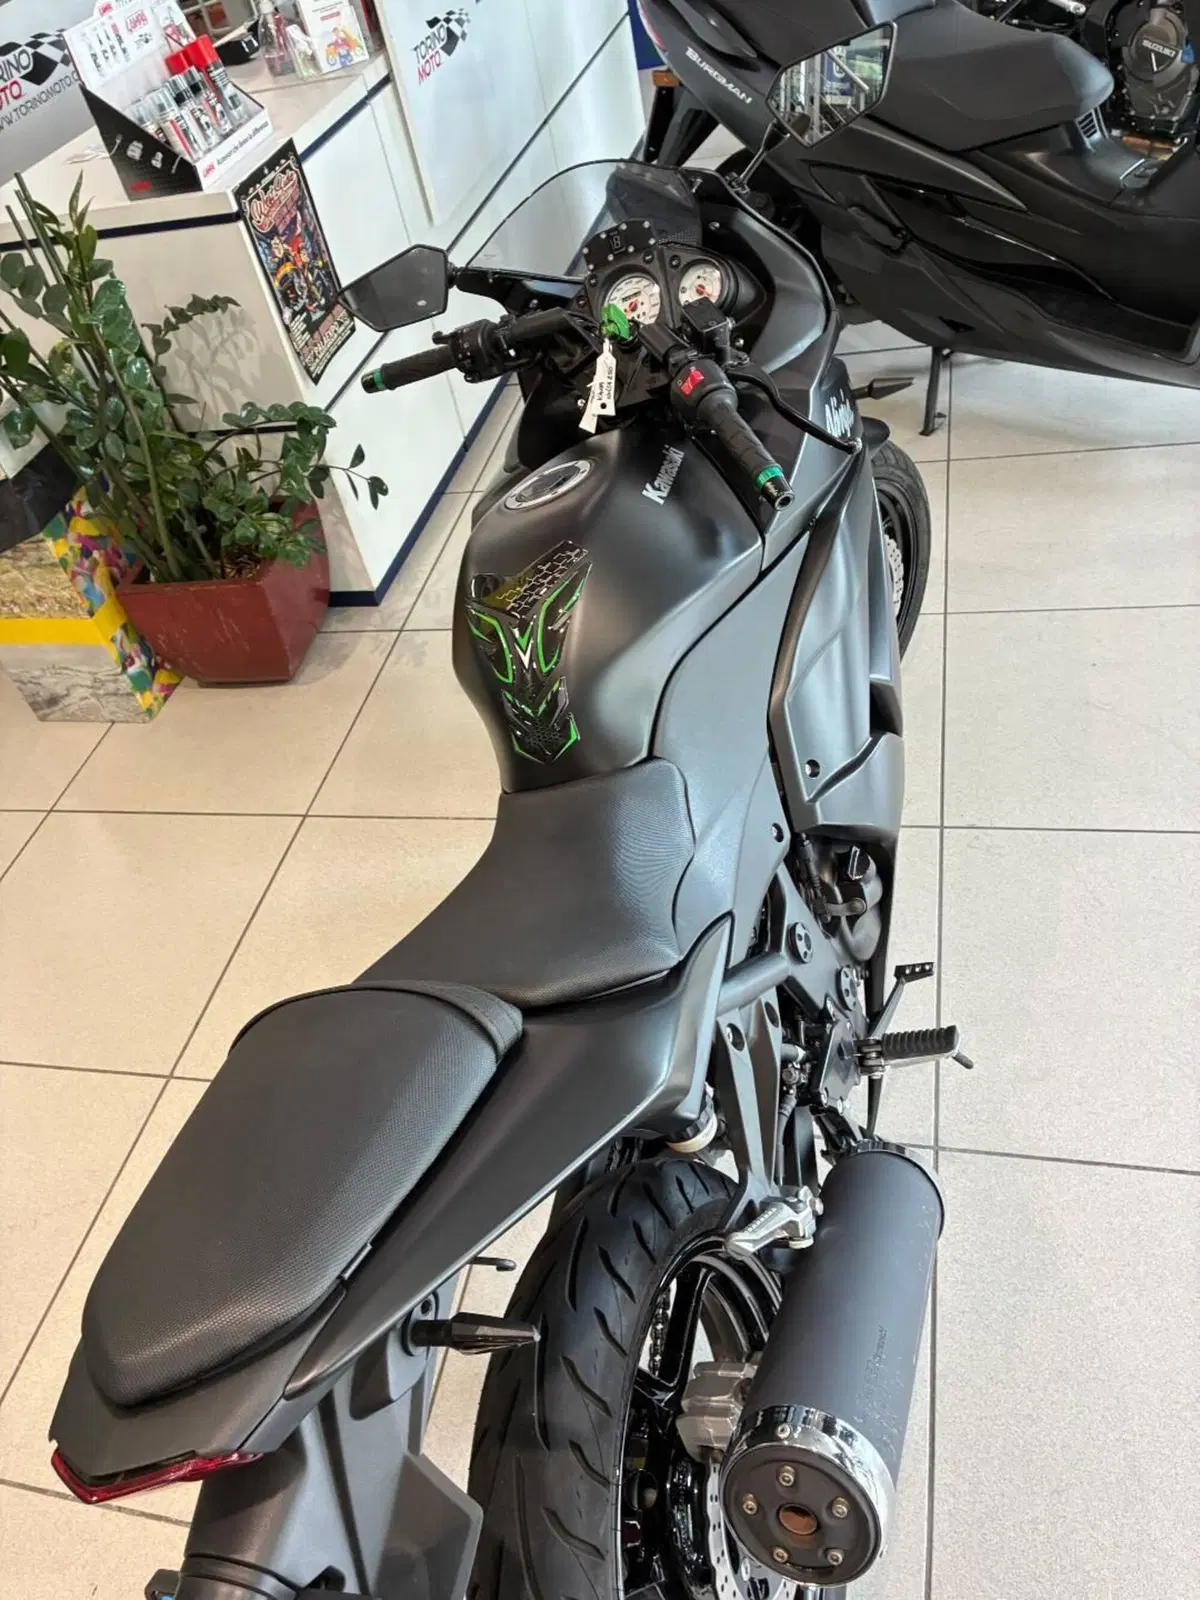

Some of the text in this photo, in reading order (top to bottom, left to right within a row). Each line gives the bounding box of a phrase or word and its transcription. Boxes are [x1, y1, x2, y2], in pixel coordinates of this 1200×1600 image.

[413, 23, 447, 65] TORINO
[1142, 39, 1176, 58] SUZUKI
[416, 50, 442, 86] MOTO
[685, 46, 753, 104] BURGMAN
[641, 444, 685, 505] Kawasaki
